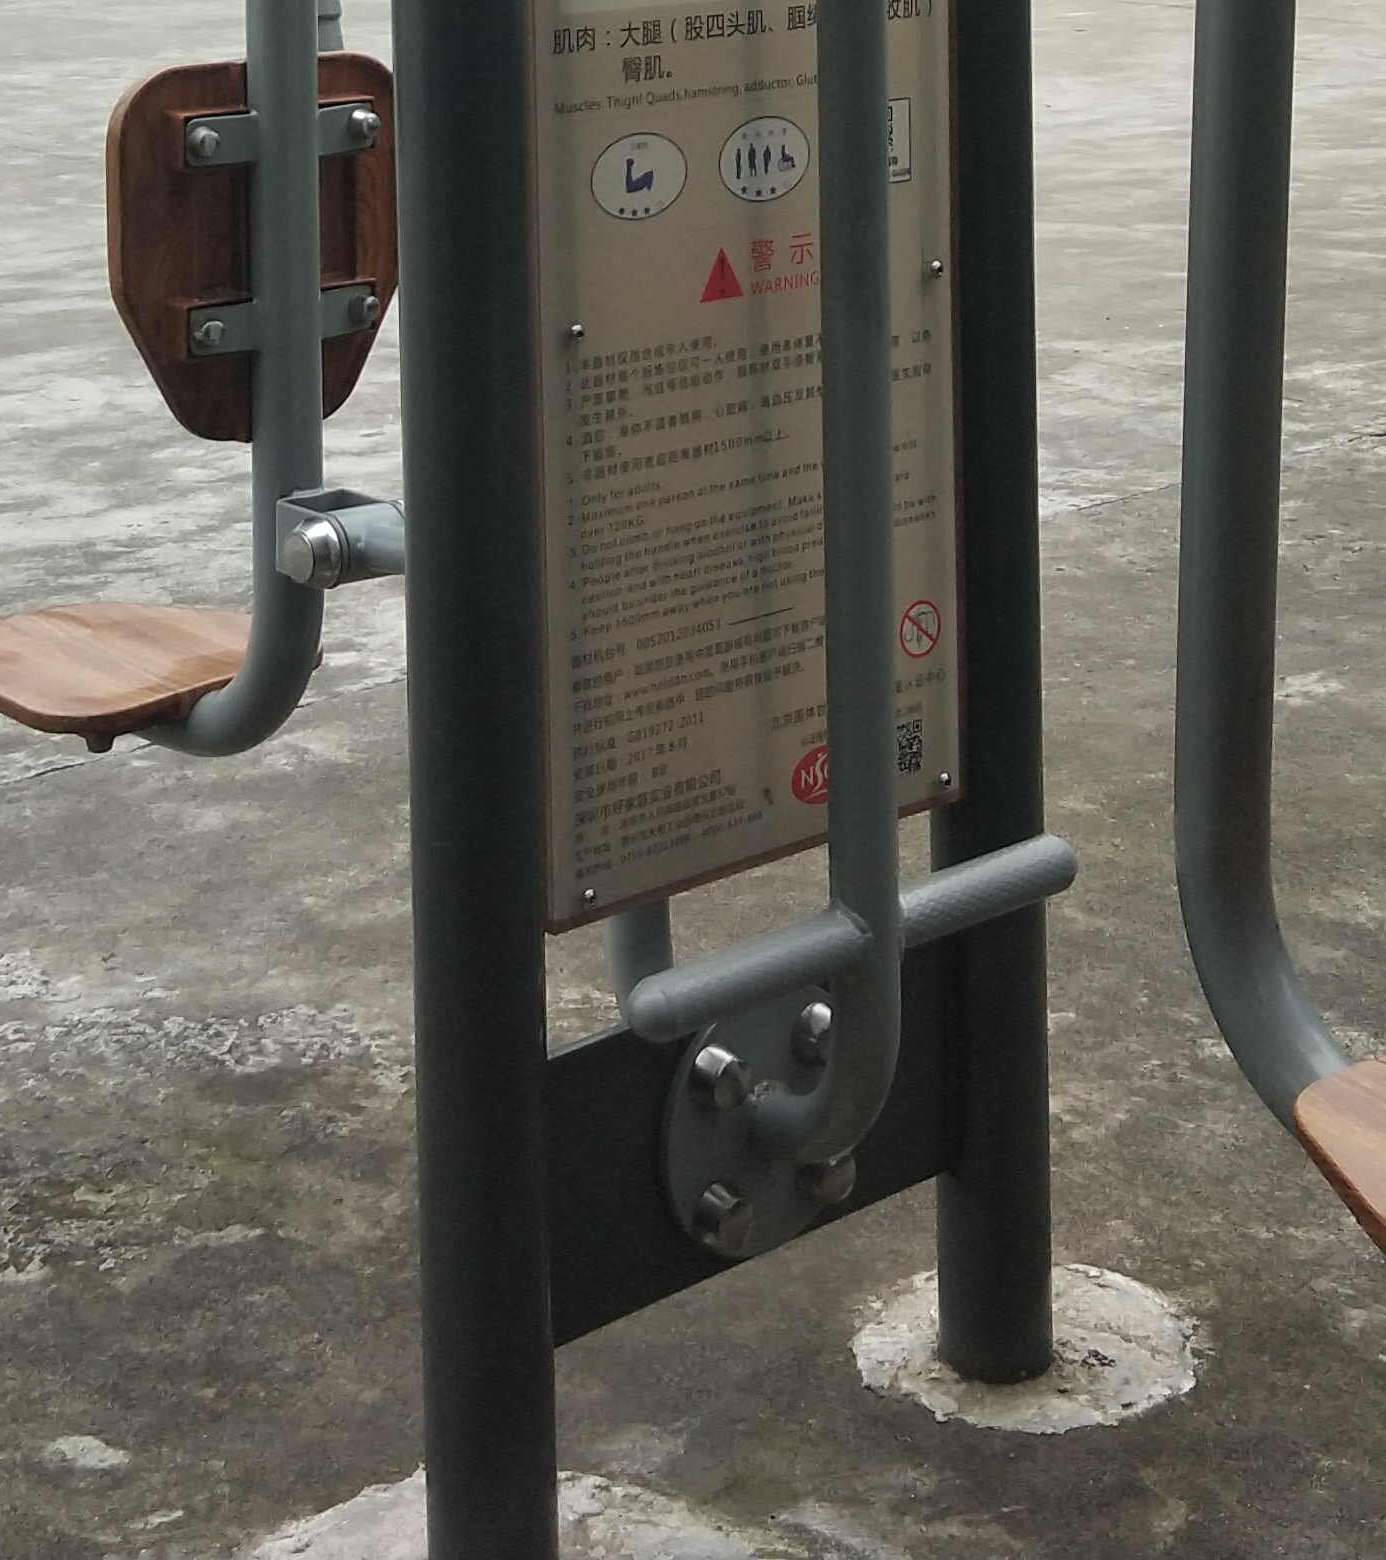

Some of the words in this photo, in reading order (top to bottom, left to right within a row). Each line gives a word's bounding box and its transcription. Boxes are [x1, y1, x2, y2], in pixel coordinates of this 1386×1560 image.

[750, 270, 820, 296] WARNING
[728, 476, 754, 489] same
[582, 490, 605, 508] Only
